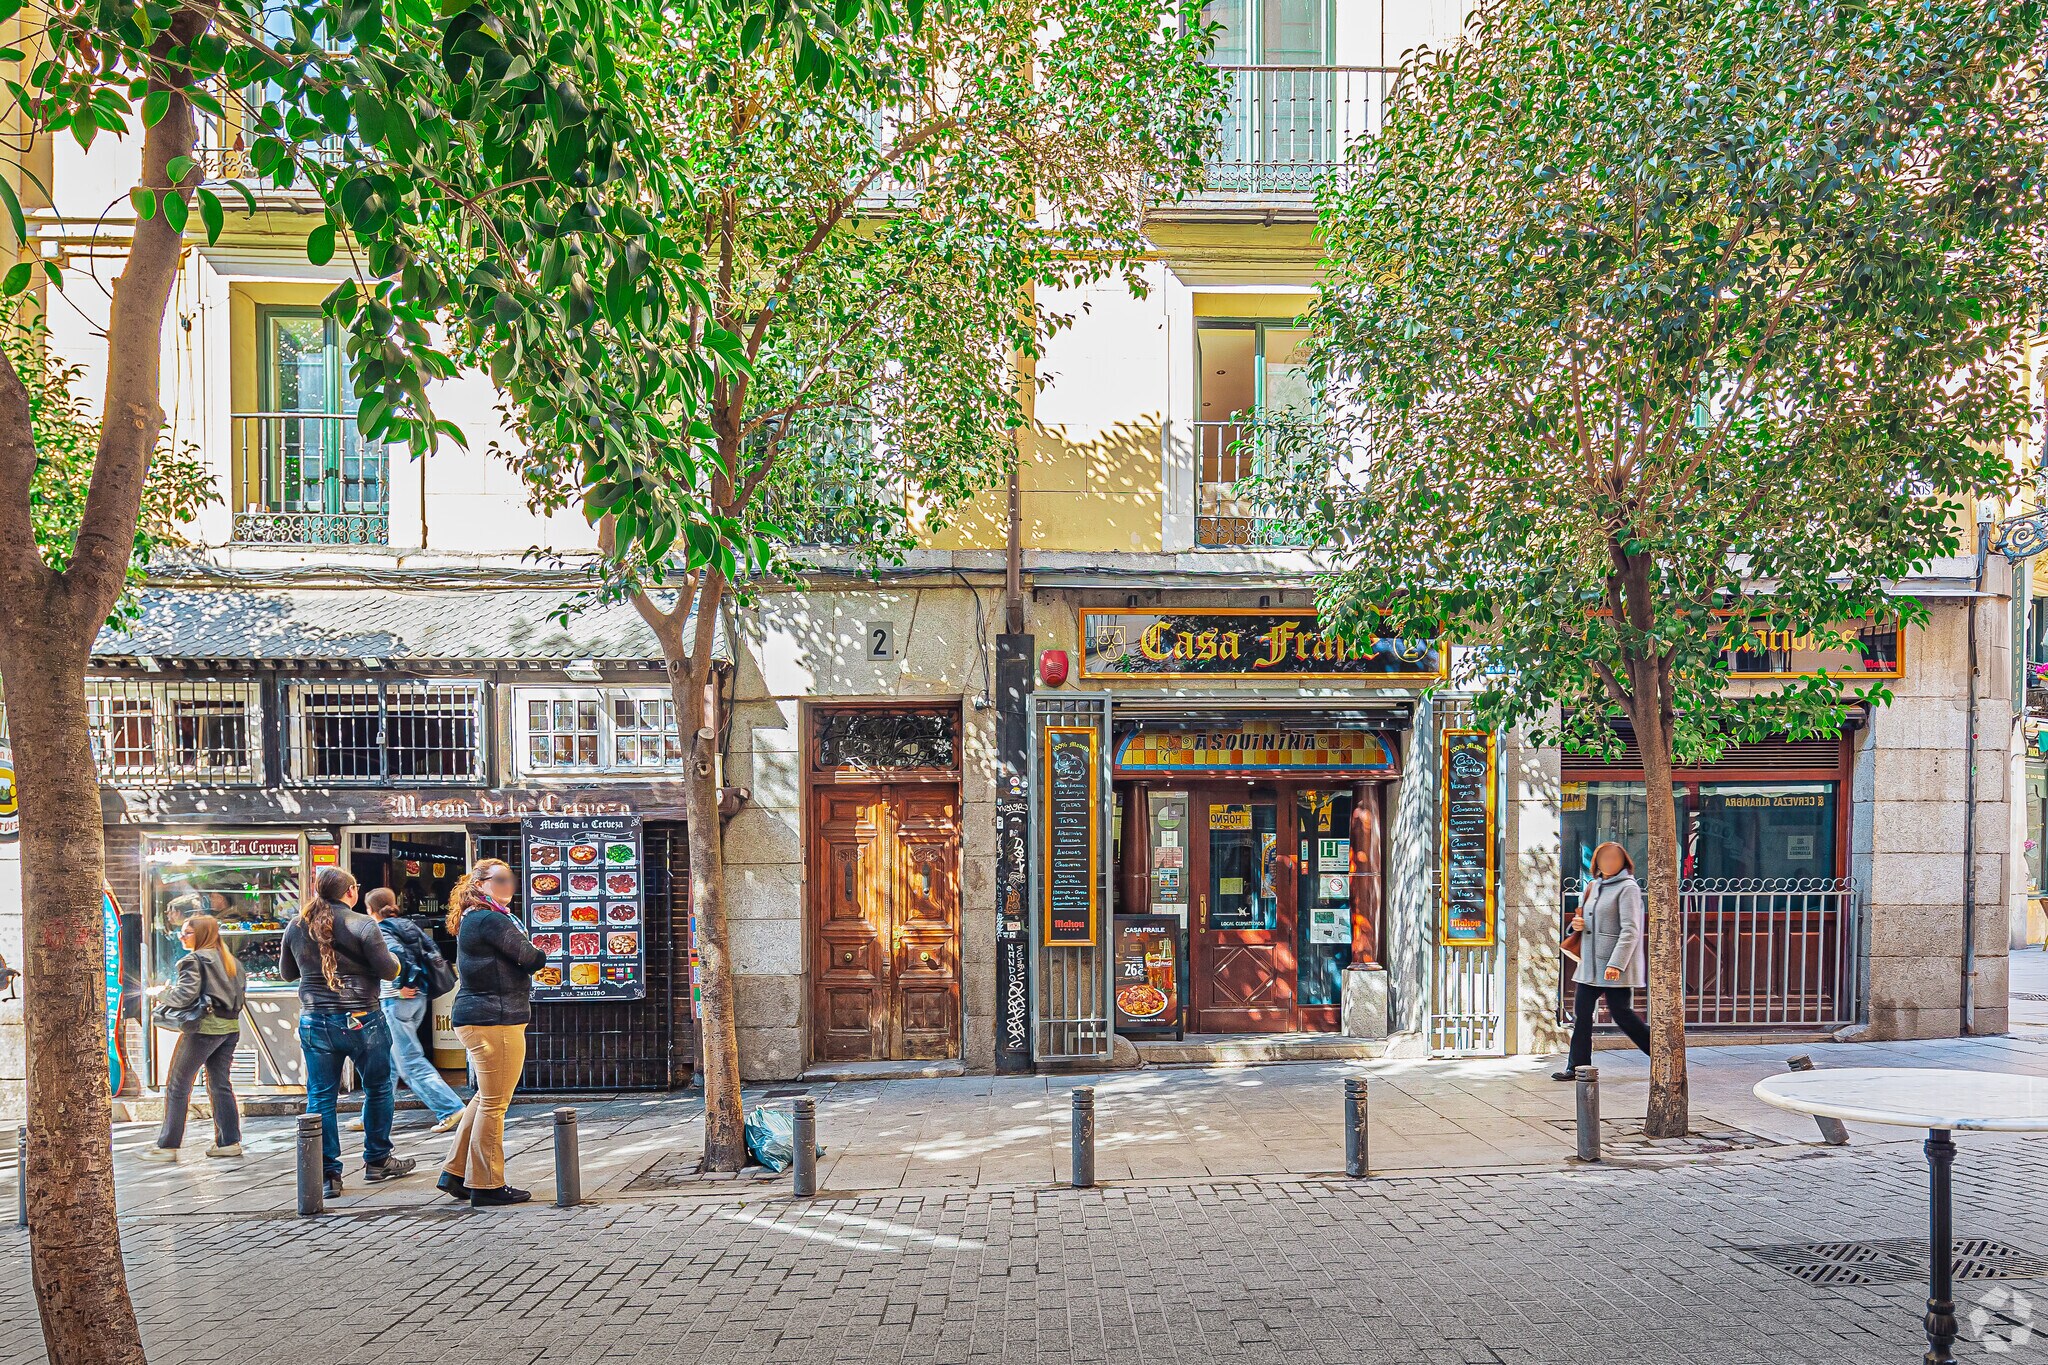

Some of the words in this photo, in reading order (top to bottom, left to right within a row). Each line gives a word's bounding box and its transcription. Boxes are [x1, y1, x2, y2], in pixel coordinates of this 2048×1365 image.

[872, 628, 887, 656] 2
[1140, 619, 1242, 661] Casa
[539, 819, 569, 830] Mesón
[591, 819, 624, 830] Cerveza
[210, 840, 226, 854] De
[229, 840, 246, 854] La
[249, 839, 297, 854] Cerveza
[1323, 841, 1338, 857] H
[1054, 919, 1085, 928] Mahou
[1449, 918, 1482, 928] Mahou
[1124, 963, 1138, 977] 26
